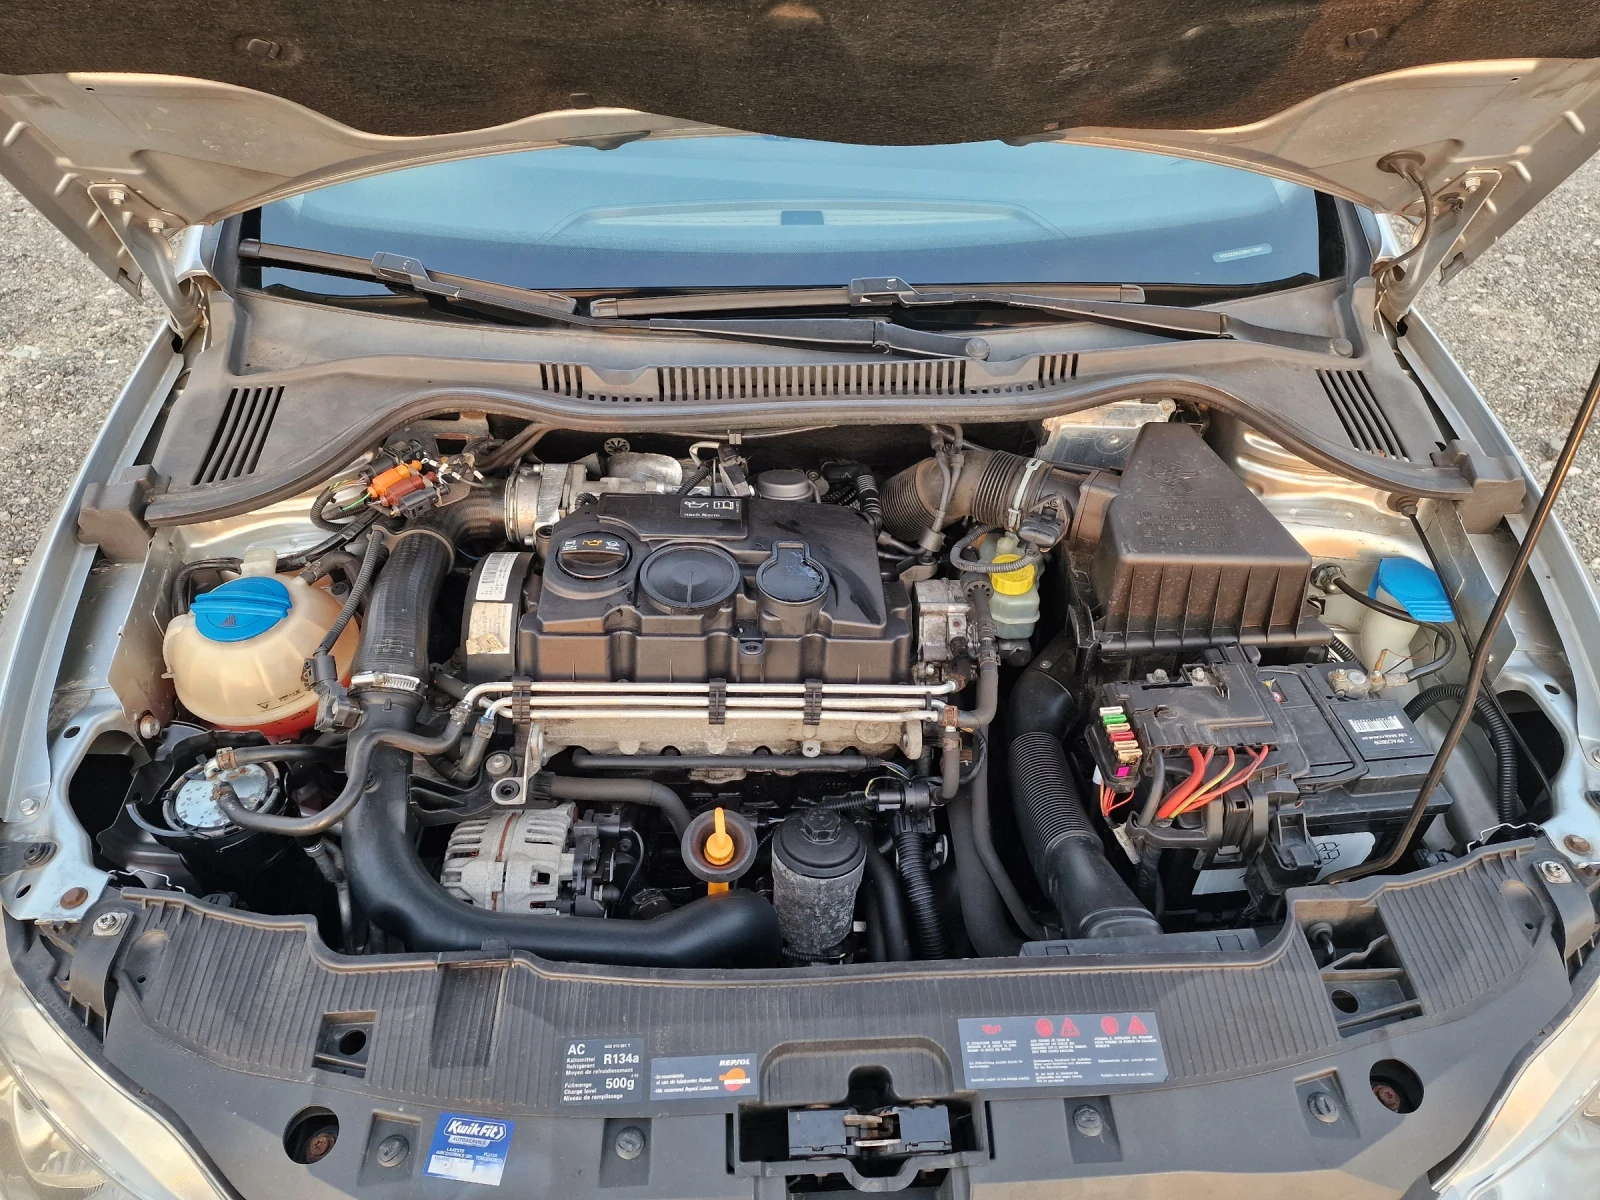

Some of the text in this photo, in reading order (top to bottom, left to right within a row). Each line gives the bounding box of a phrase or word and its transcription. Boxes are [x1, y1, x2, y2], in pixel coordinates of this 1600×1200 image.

[567, 1043, 585, 1055] AC
[603, 1053, 639, 1065] R134a
[719, 1058, 750, 1066] REPSOL
[605, 1077, 635, 1090] 500g
[452, 1136, 487, 1145] AUTOSERVICE
